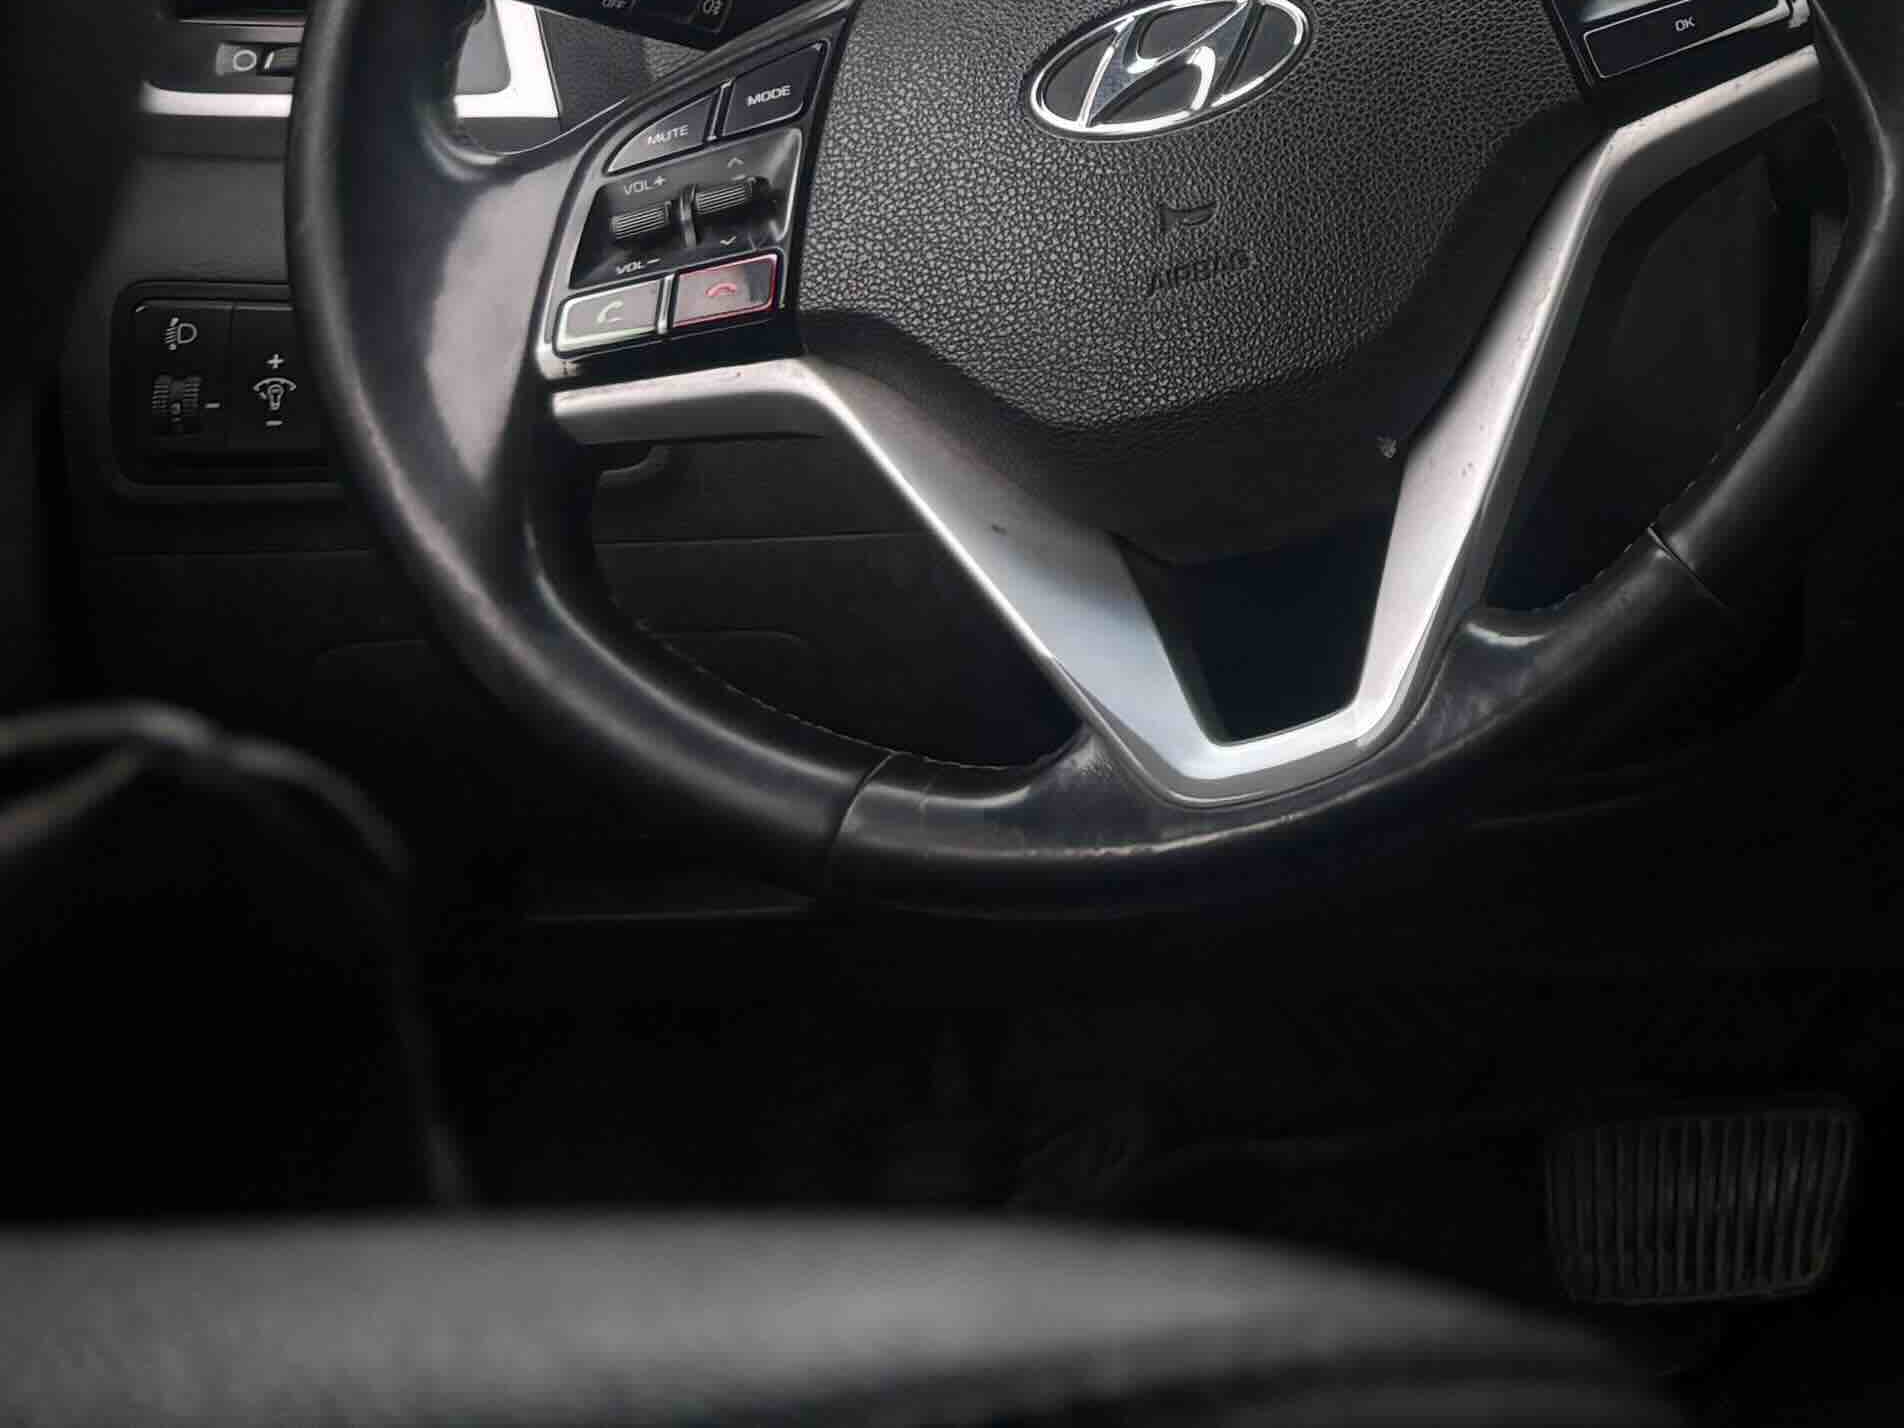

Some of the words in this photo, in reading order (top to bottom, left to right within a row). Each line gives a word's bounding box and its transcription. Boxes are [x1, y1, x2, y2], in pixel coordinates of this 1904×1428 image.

[1674, 14, 1696, 32] OK
[747, 84, 792, 107] MODE
[647, 124, 690, 145] MUTE
